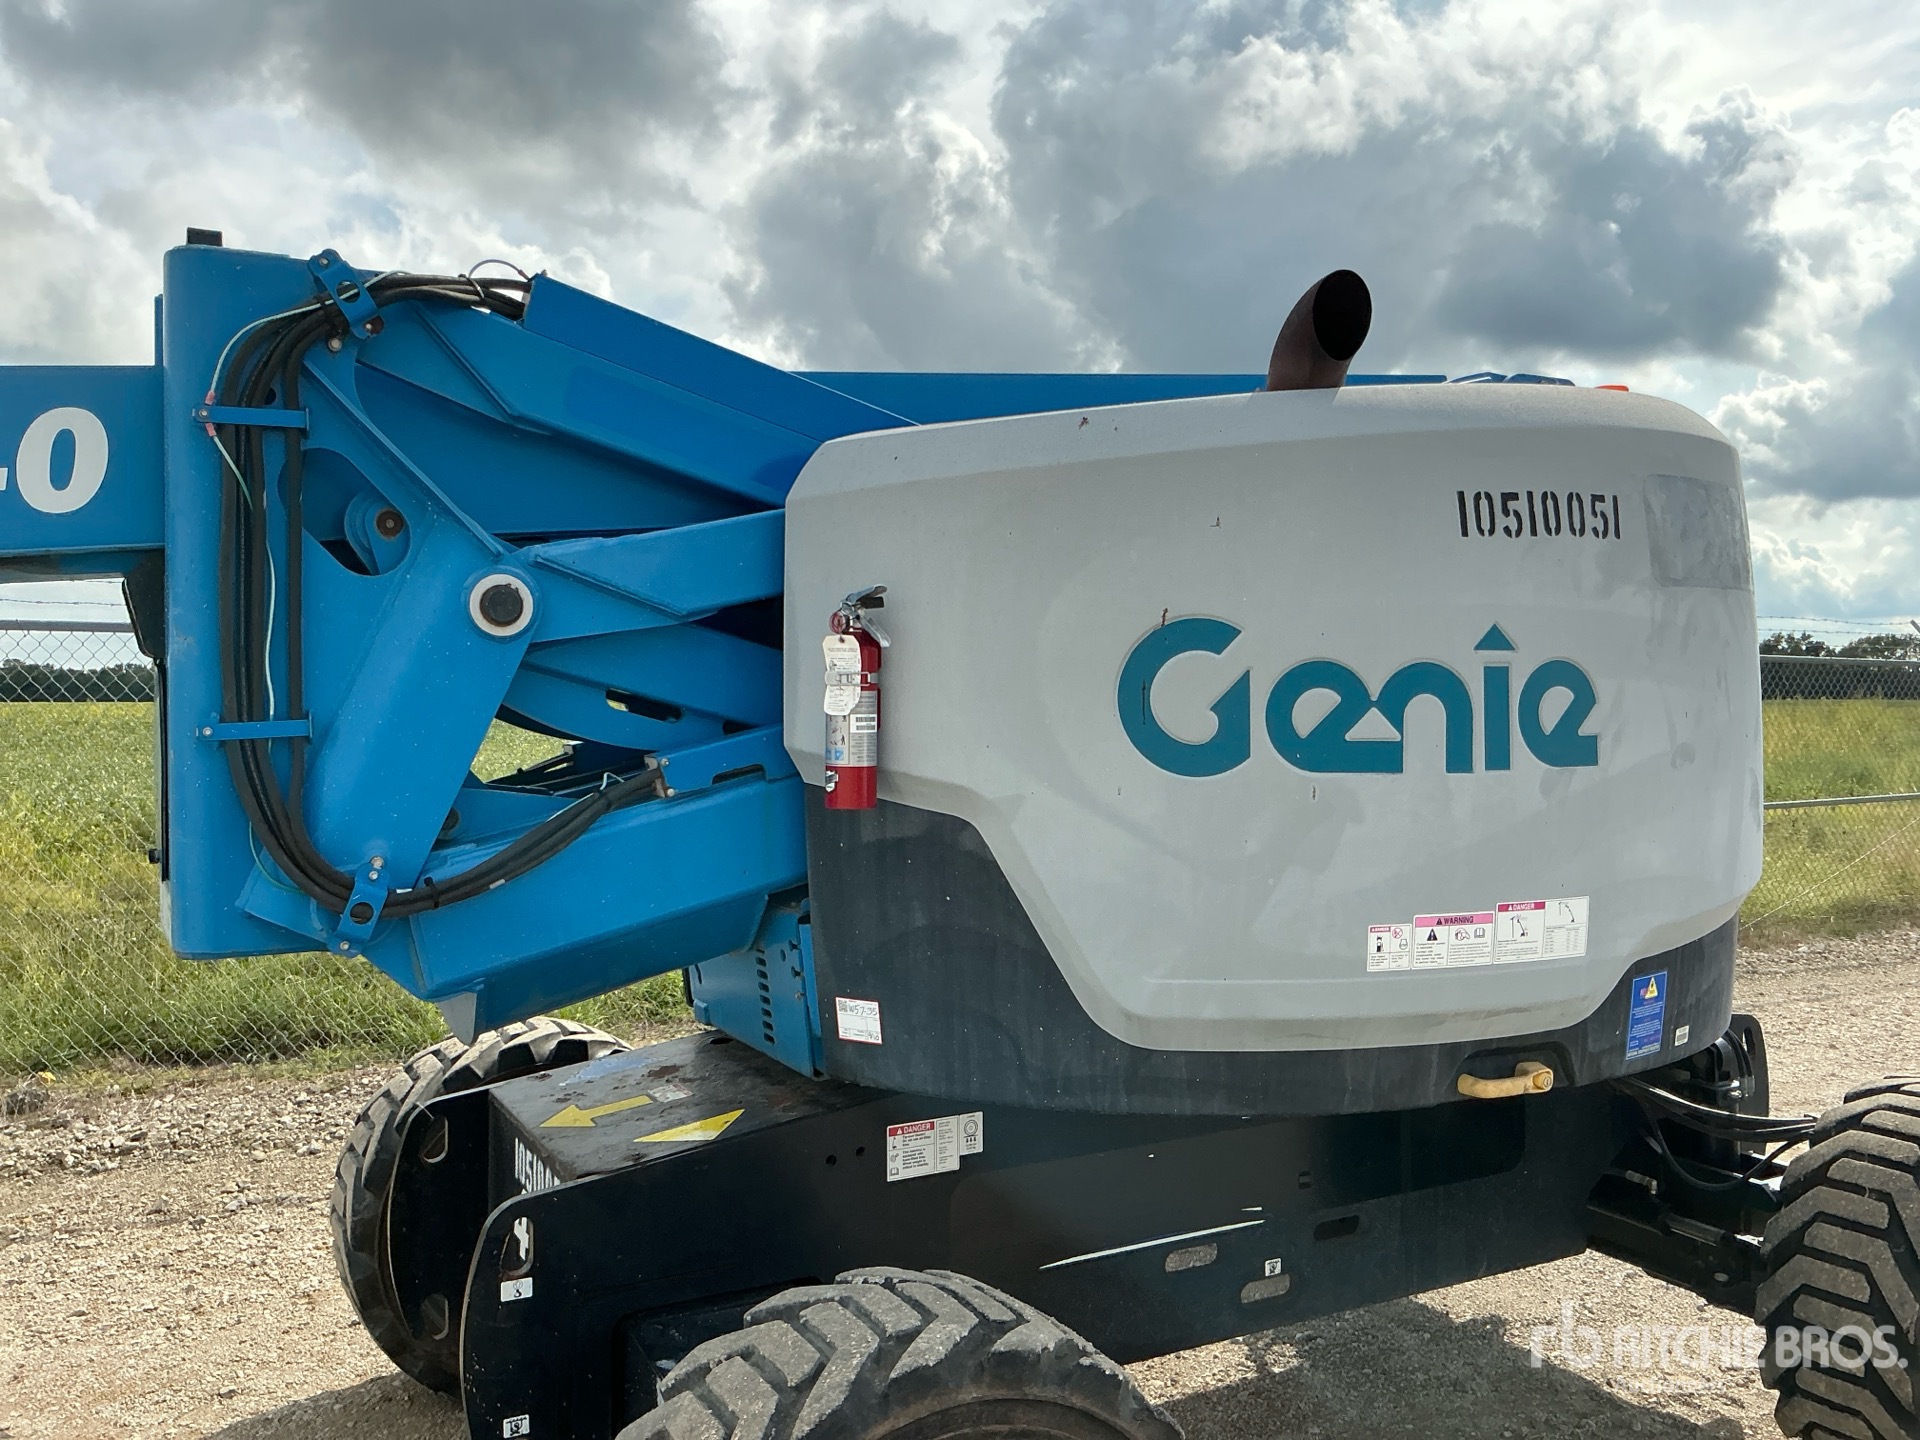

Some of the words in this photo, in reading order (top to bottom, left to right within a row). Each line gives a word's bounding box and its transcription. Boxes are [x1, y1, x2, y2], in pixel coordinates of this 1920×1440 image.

[1456, 490, 1621, 539] 10510051
[1117, 617, 1599, 778] Genie
[1443, 916, 1474, 925] WARNING
[903, 1122, 931, 1134] DANGER
